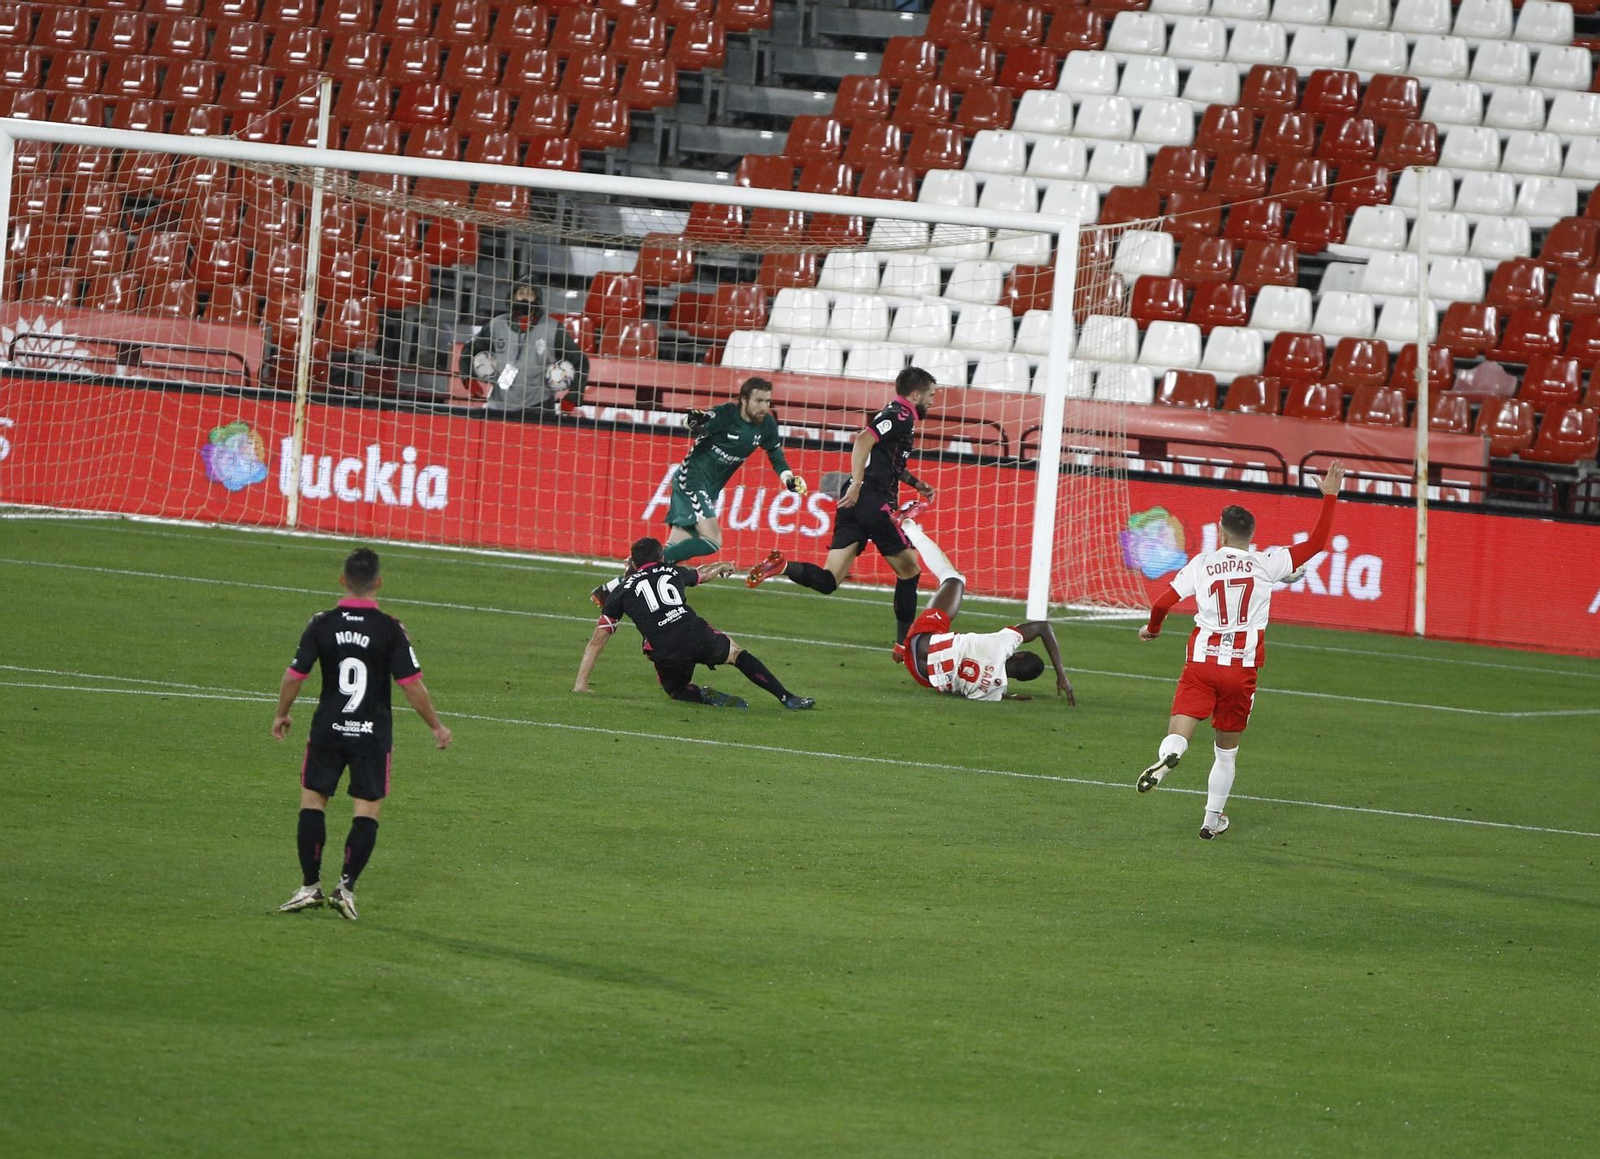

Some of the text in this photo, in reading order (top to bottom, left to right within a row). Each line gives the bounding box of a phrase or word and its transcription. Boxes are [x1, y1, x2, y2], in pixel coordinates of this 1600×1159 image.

[279, 436, 449, 511] luckia
[641, 463, 833, 537] Aues
[1206, 560, 1253, 576] CORPAS
[635, 575, 684, 613] 16
[1208, 577, 1255, 627] 17
[335, 630, 370, 648] NONO
[338, 657, 368, 713] 9
